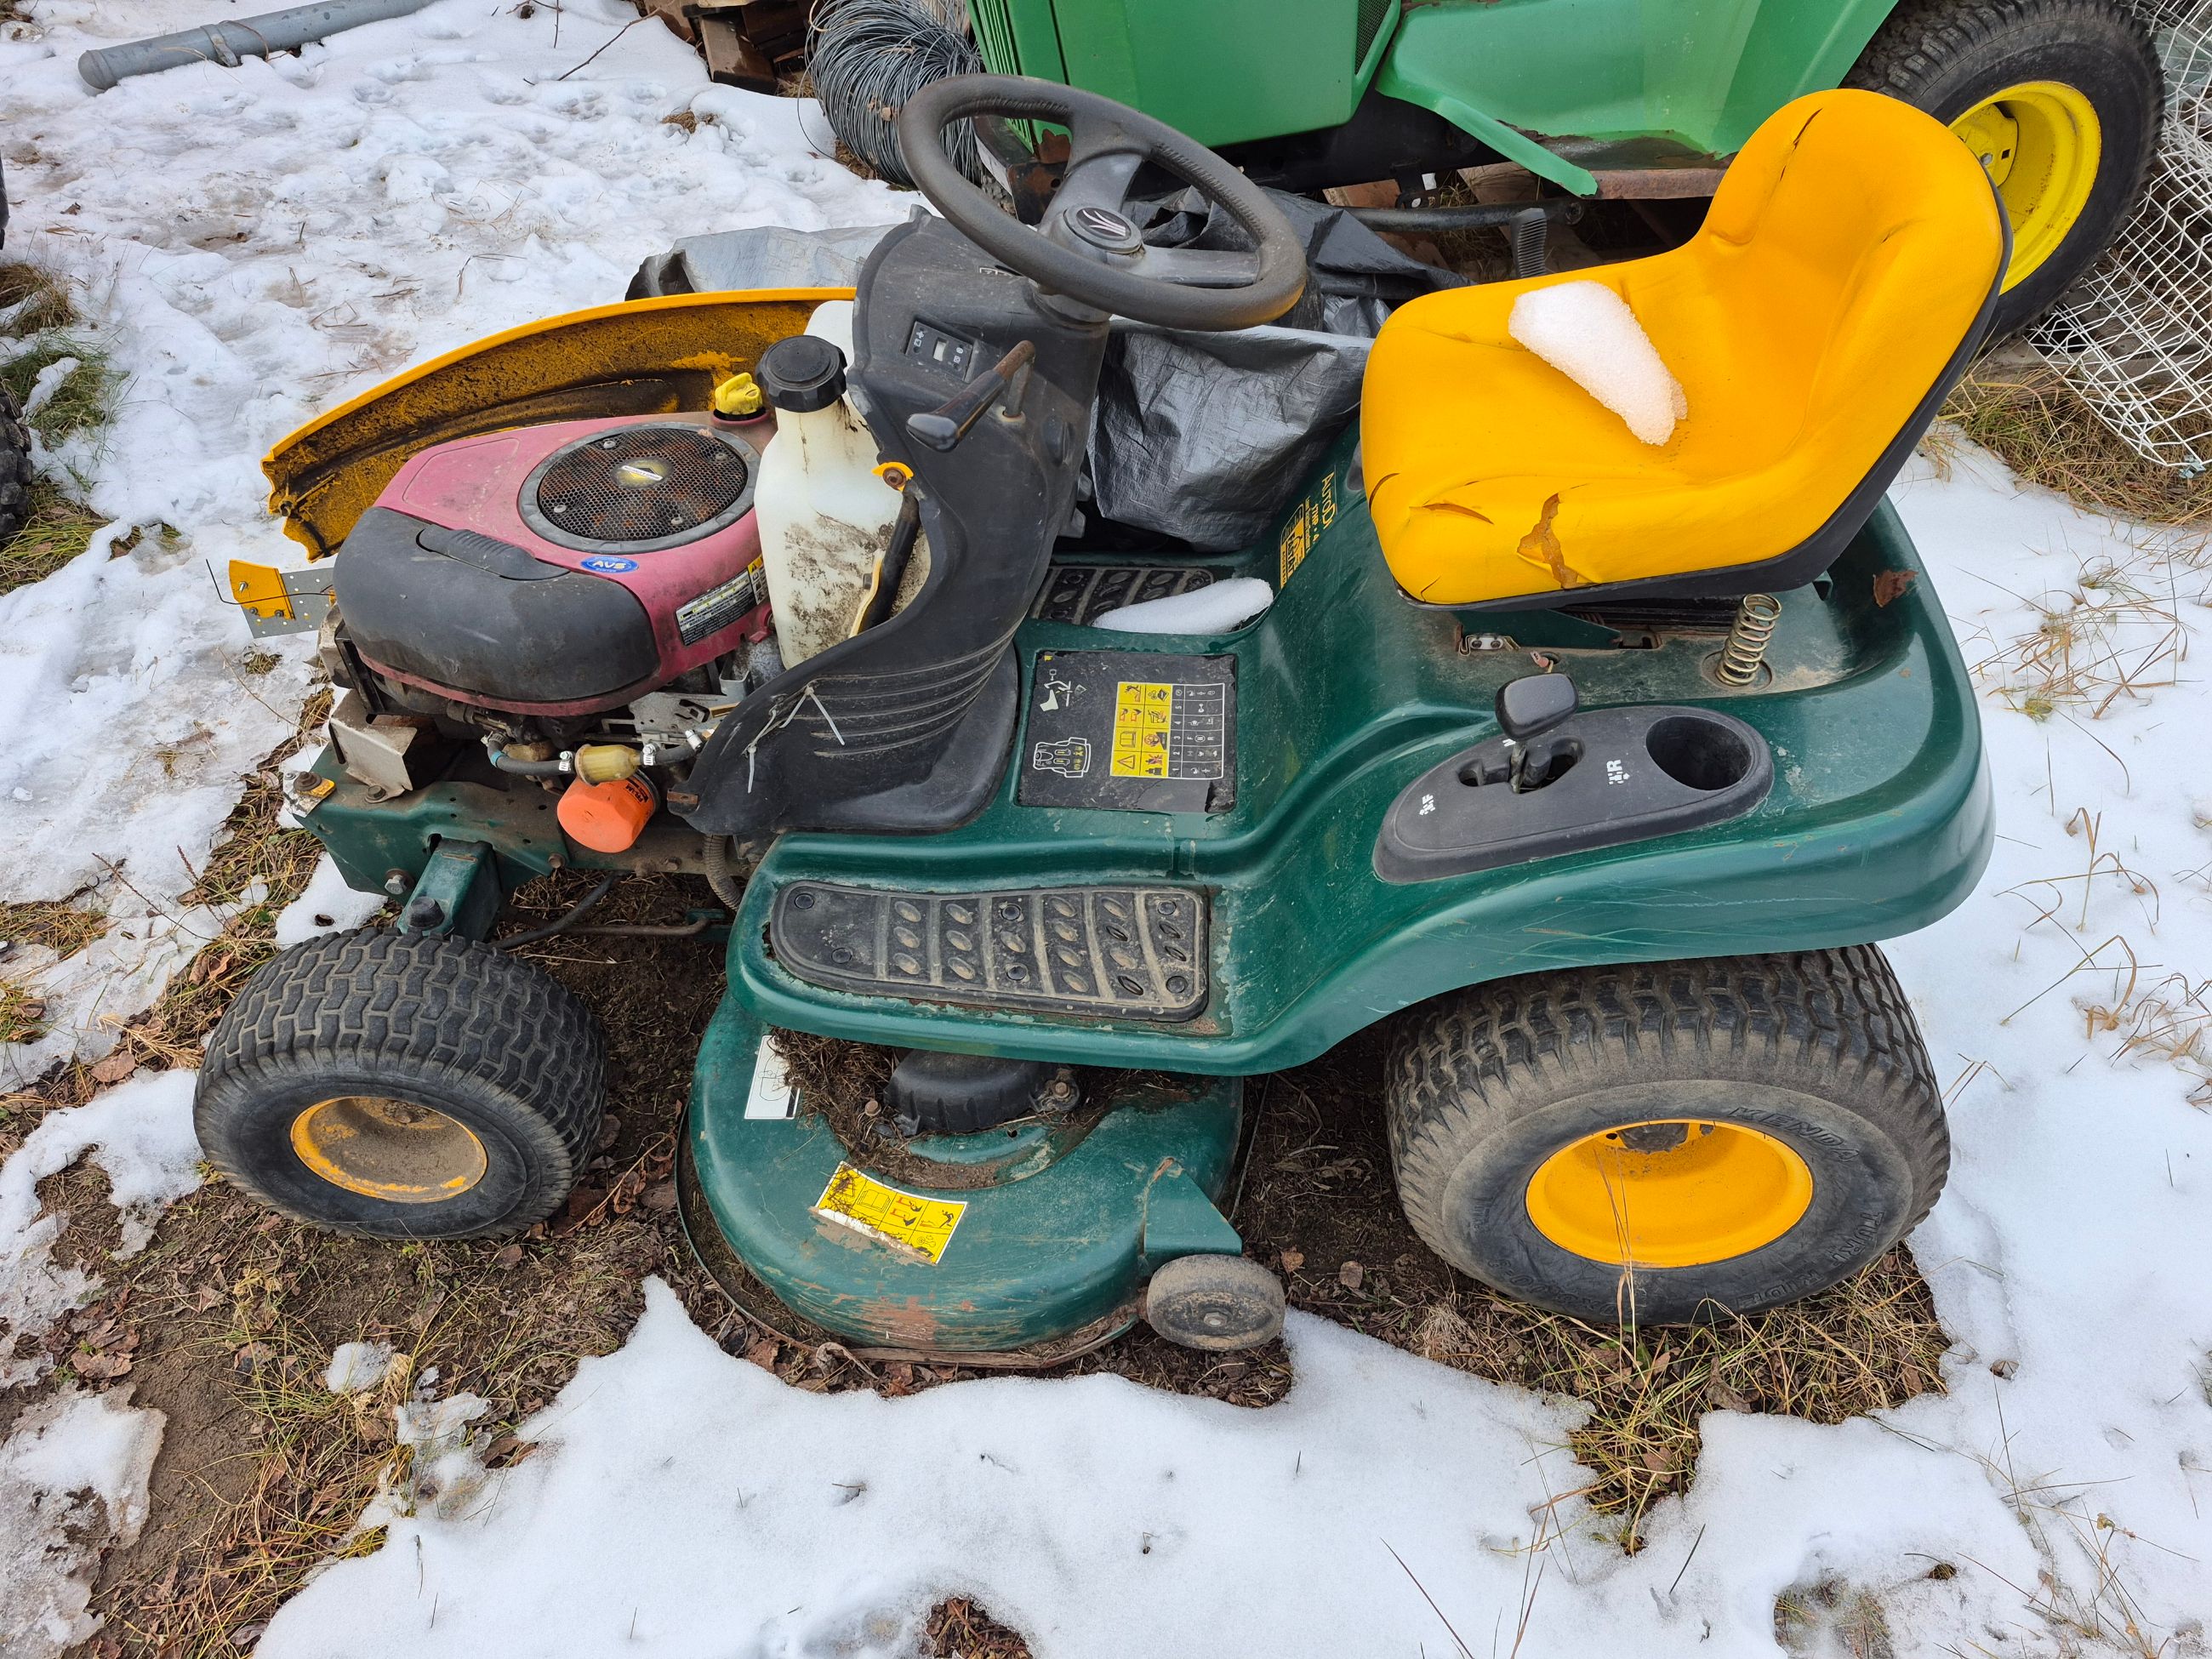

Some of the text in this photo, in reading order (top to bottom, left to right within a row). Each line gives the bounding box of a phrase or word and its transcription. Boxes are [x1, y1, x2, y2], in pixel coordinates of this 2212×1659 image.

[592, 561, 626, 569] AVS
[1606, 759, 1622, 772] R
[1422, 794, 1434, 805] F
[1728, 1107, 1860, 1162] KENDA
[1736, 1211, 1884, 1309] TURF RIDE
